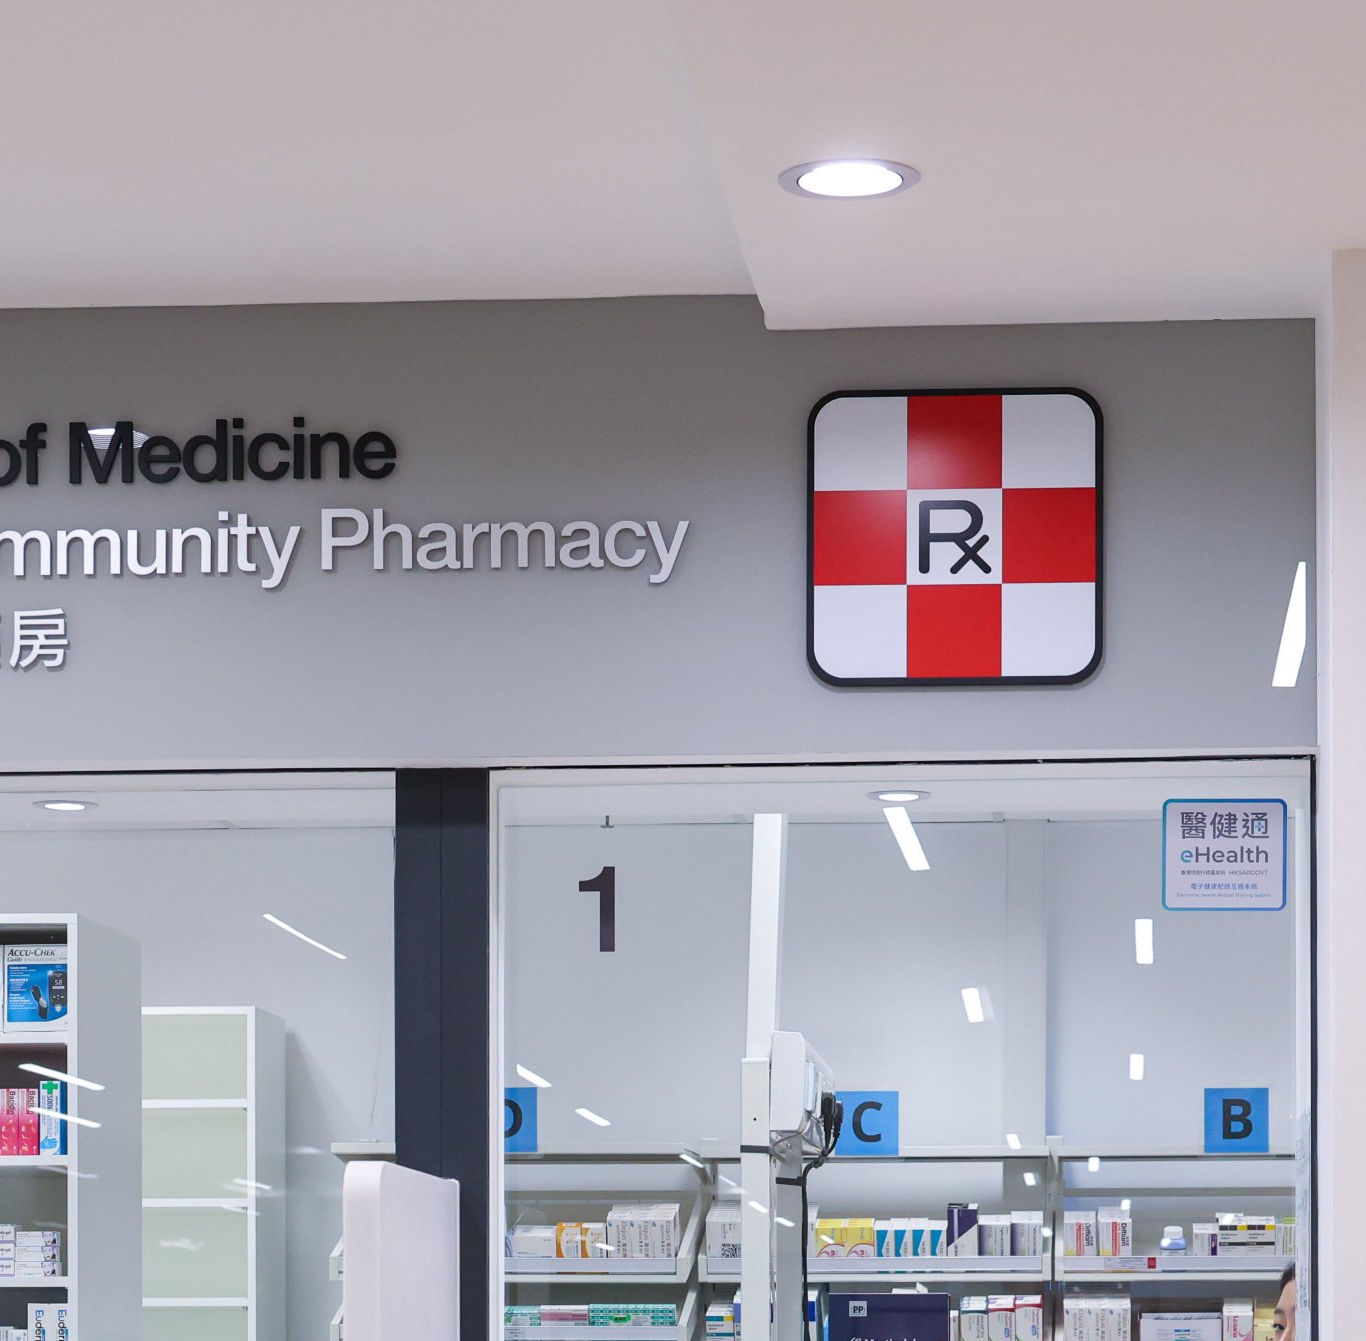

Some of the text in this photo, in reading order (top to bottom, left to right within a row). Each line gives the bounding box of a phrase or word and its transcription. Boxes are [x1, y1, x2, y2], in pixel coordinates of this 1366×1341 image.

[67, 417, 397, 483] Medicine
[319, 508, 688, 583] Pharmacy
[915, 500, 993, 575] Rx
[1180, 811, 1270, 840] 醫健通
[1180, 846, 1269, 864] eHealth
[579, 866, 615, 952] 1
[851, 1101, 883, 1143] C
[1222, 1098, 1253, 1140] B
